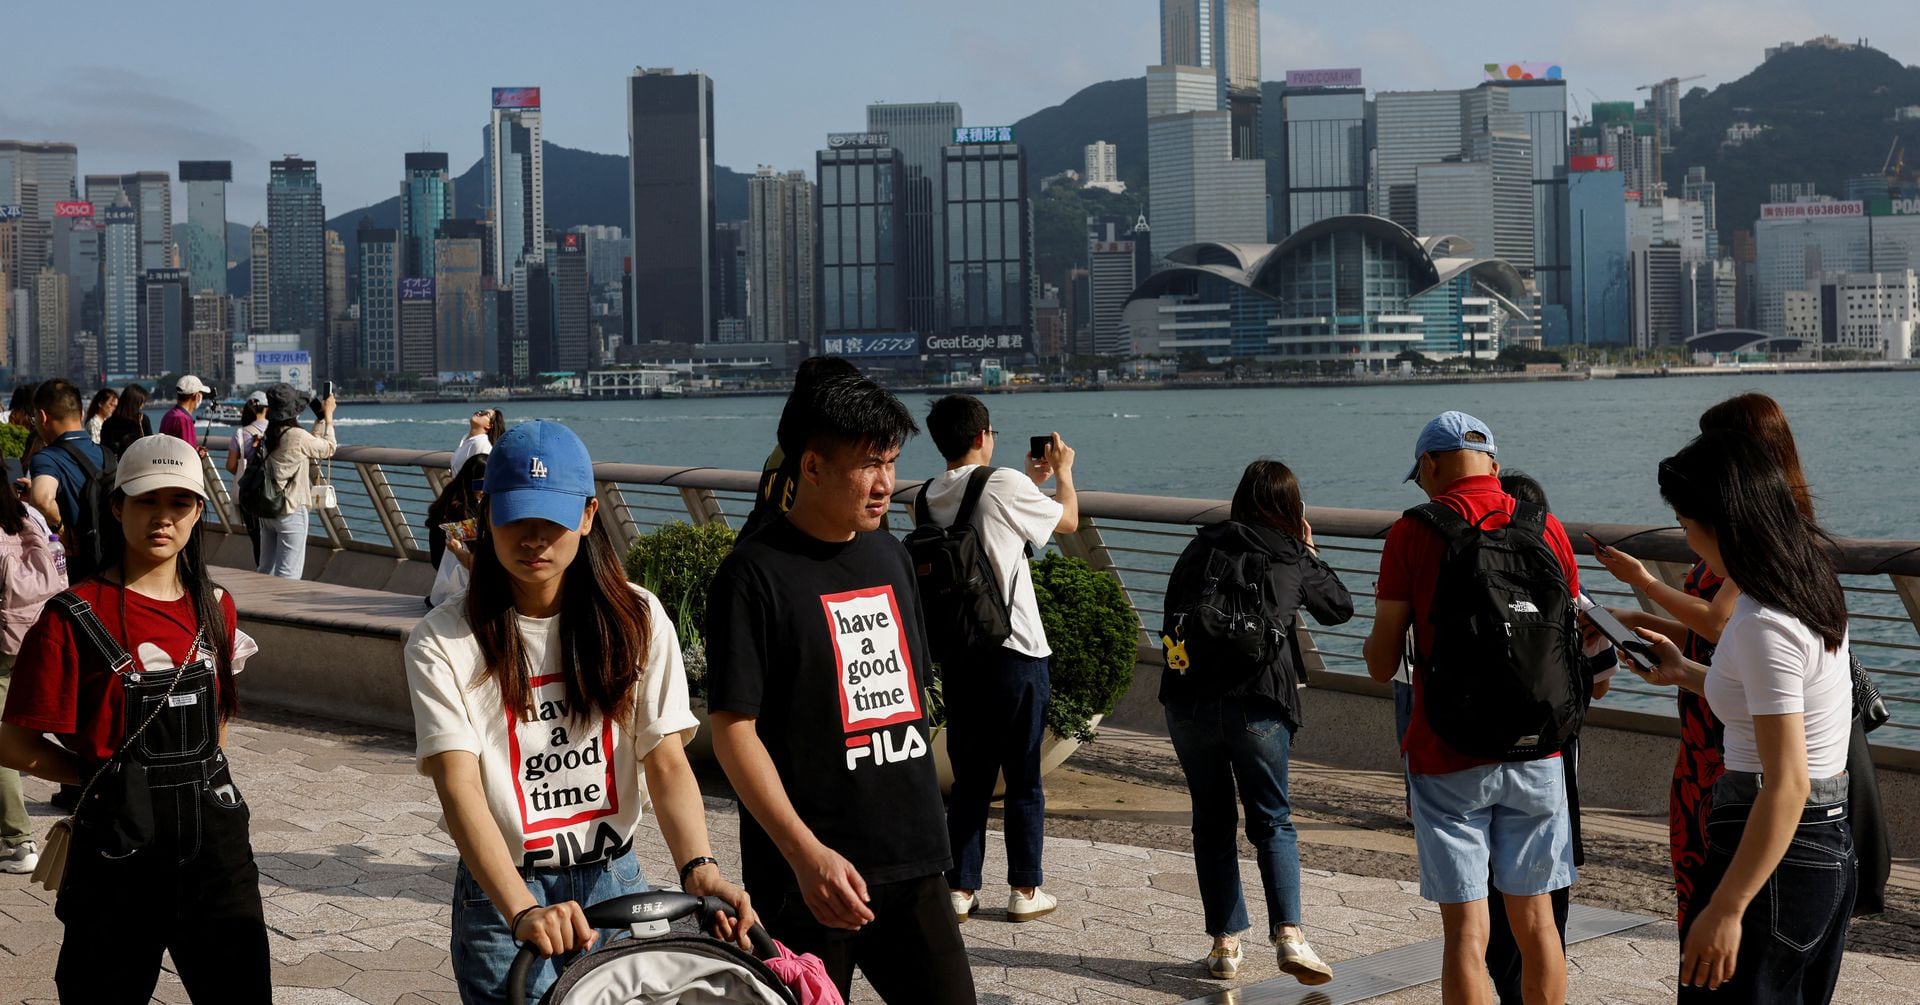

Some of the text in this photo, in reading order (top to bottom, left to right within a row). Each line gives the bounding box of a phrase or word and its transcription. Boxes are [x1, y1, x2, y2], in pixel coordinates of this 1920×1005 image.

[956, 127, 1011, 142] 累積財富
[1807, 203, 1860, 216] 69388093
[403, 278, 431, 288] イオン
[403, 288, 432, 298] カード
[927, 335, 960, 350] Great
[962, 335, 994, 352] Eagle
[152, 458, 184, 467] HOLIDAY
[531, 457, 548, 477] LA
[835, 609, 890, 635] have
[861, 637, 876, 656] a
[847, 649, 901, 685] good
[853, 686, 905, 712] time
[551, 726, 569, 748] a
[845, 725, 928, 771] FILA
[525, 736, 602, 781] good
[530, 782, 601, 812] time
[523, 821, 634, 876] FILA
[631, 902, 664, 914] 好孩子
